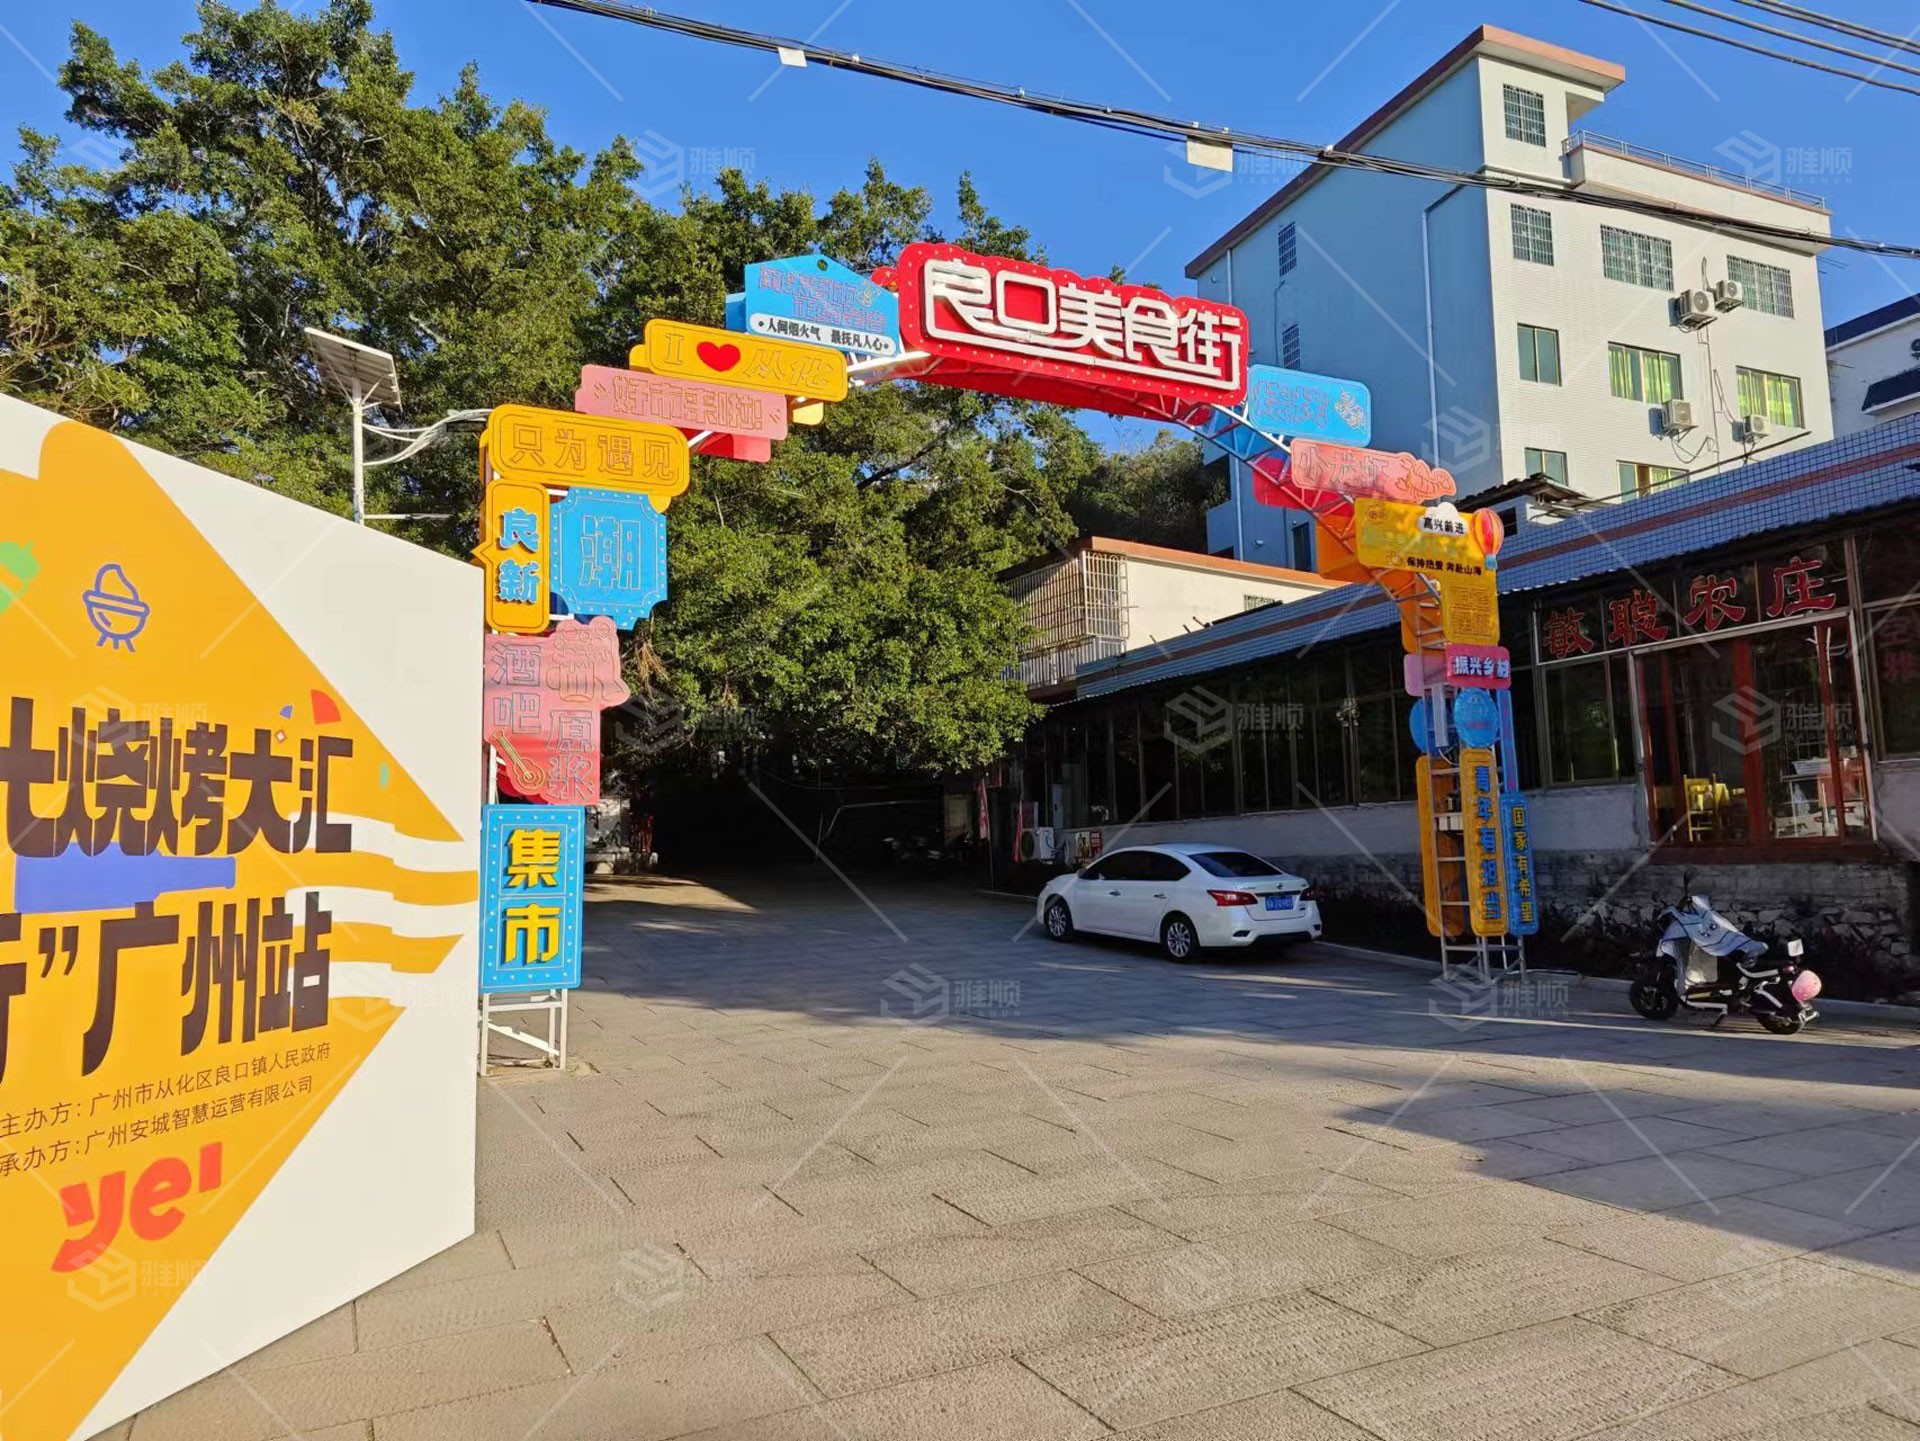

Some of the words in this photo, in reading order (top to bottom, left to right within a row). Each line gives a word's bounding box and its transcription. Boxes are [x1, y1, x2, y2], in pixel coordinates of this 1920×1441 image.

[664, 333, 684, 365] I
[744, 349, 835, 389] 从化
[767, 318, 821, 341] 人间烟火气
[831, 329, 883, 351] 最抚凡人心
[924, 258, 1241, 390] 良口美食街
[512, 423, 682, 480] 只为遇见
[1300, 447, 1390, 487] 小龙虾
[499, 507, 542, 604] 良新
[579, 515, 641, 591] 潮
[490, 641, 541, 735] 酒吧
[1455, 655, 1510, 678] 振兴乡村
[546, 709, 595, 801] 原浆
[504, 828, 561, 965] 集市
